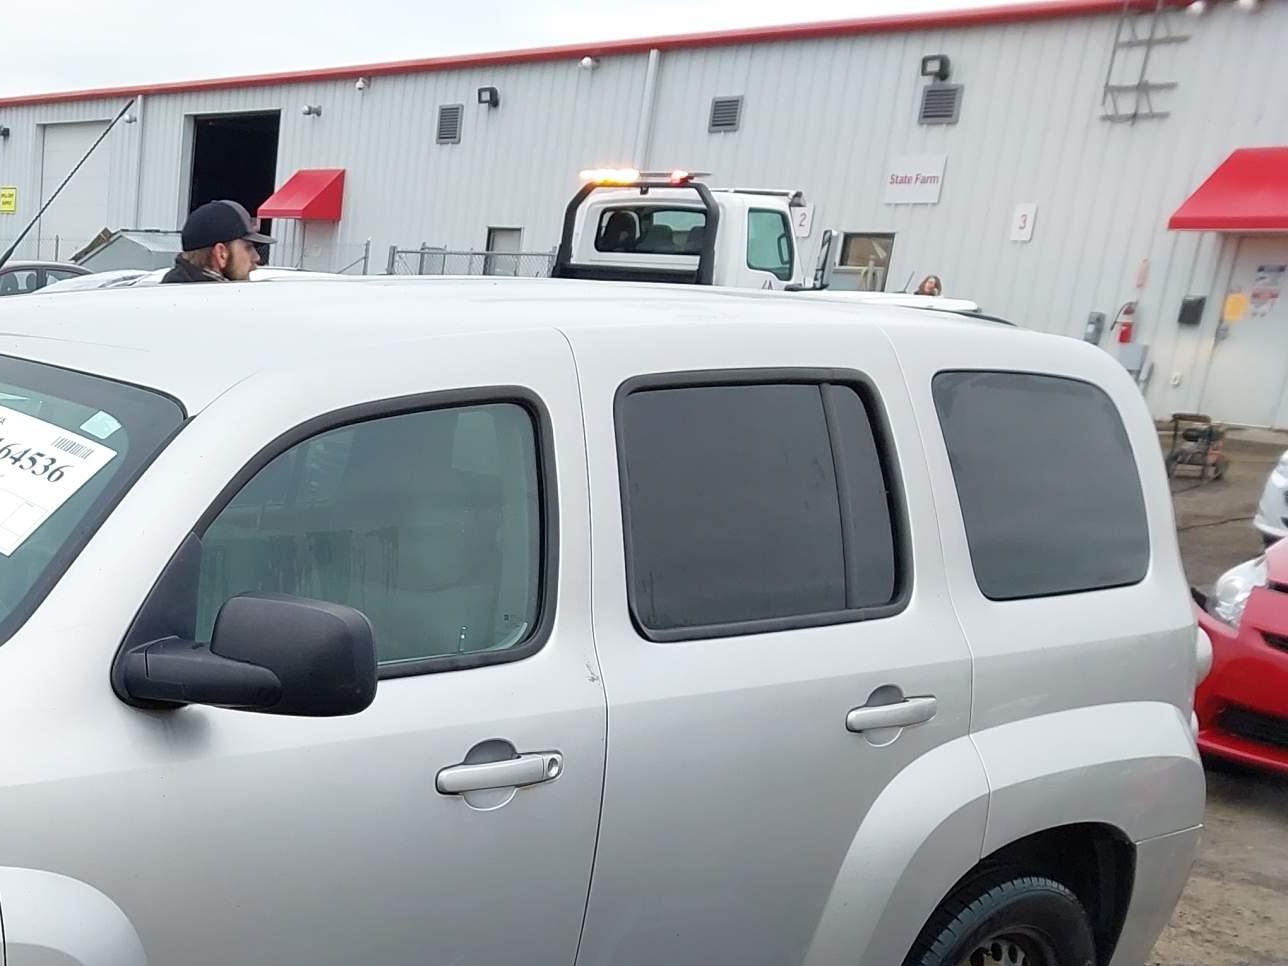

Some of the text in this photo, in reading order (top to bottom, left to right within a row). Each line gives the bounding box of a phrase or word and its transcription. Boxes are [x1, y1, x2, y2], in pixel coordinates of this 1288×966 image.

[889, 172, 939, 185] State Farm
[799, 211, 808, 227] 2
[1018, 213, 1027, 230] 3
